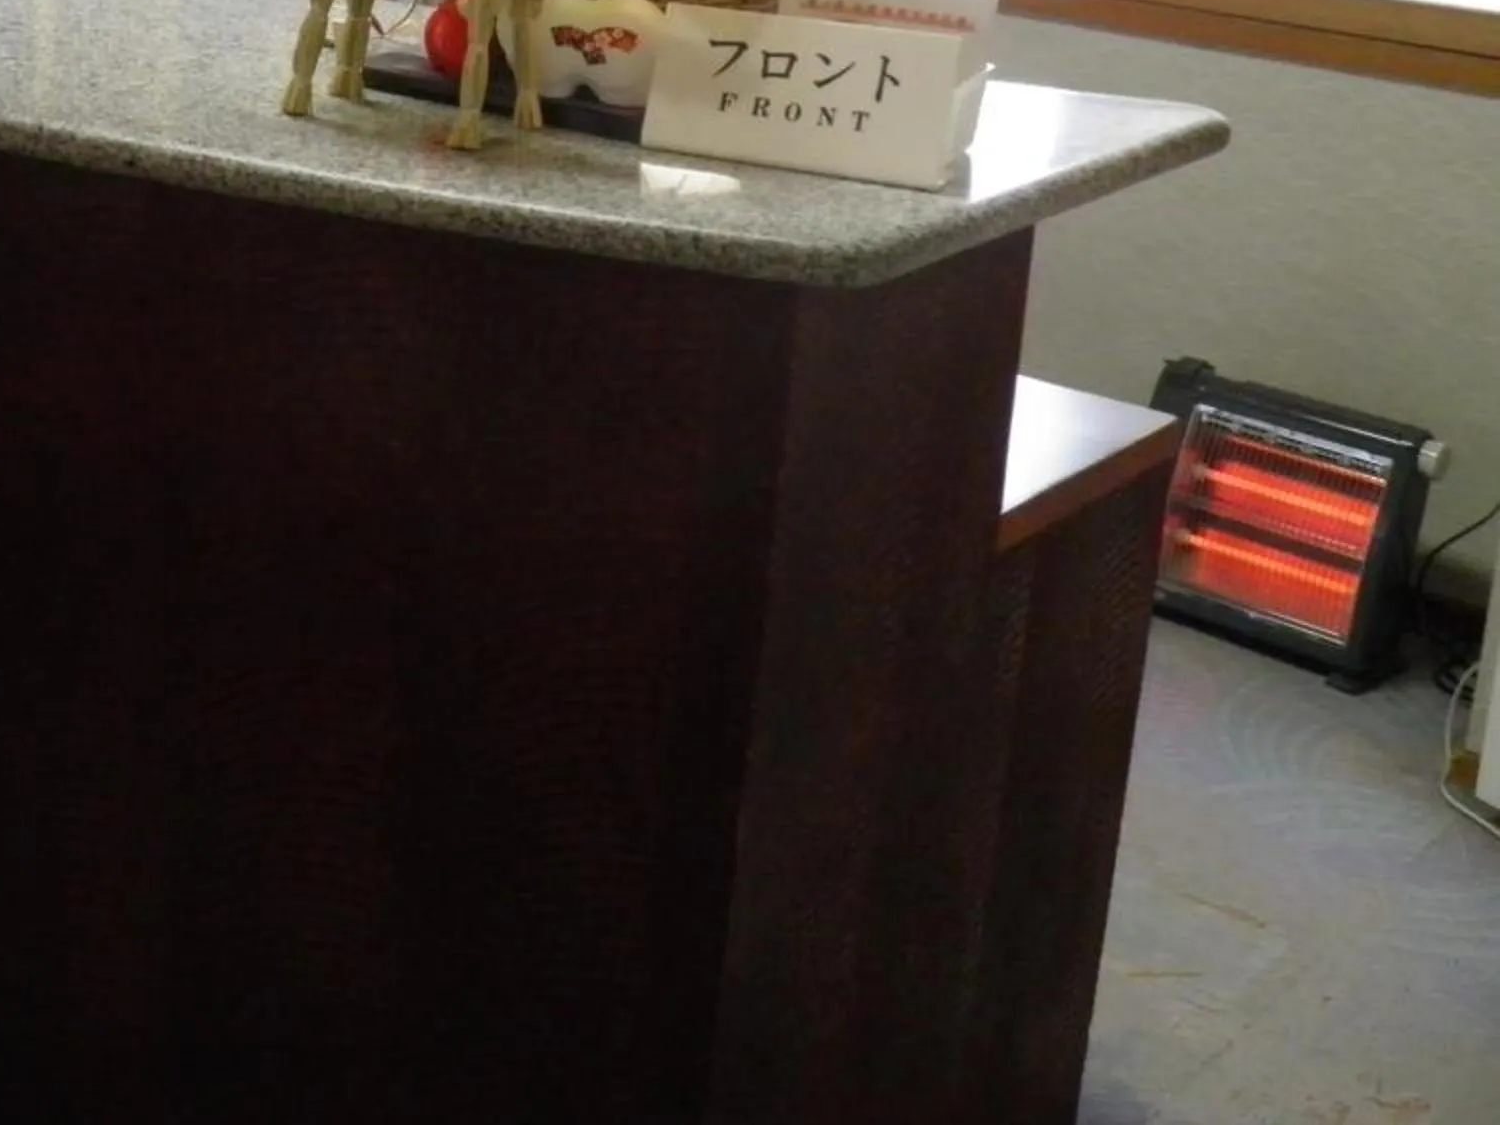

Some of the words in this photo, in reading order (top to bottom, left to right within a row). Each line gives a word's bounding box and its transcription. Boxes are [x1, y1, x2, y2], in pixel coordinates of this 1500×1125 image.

[709, 39, 900, 103] フロント
[717, 91, 870, 132] FRONT
